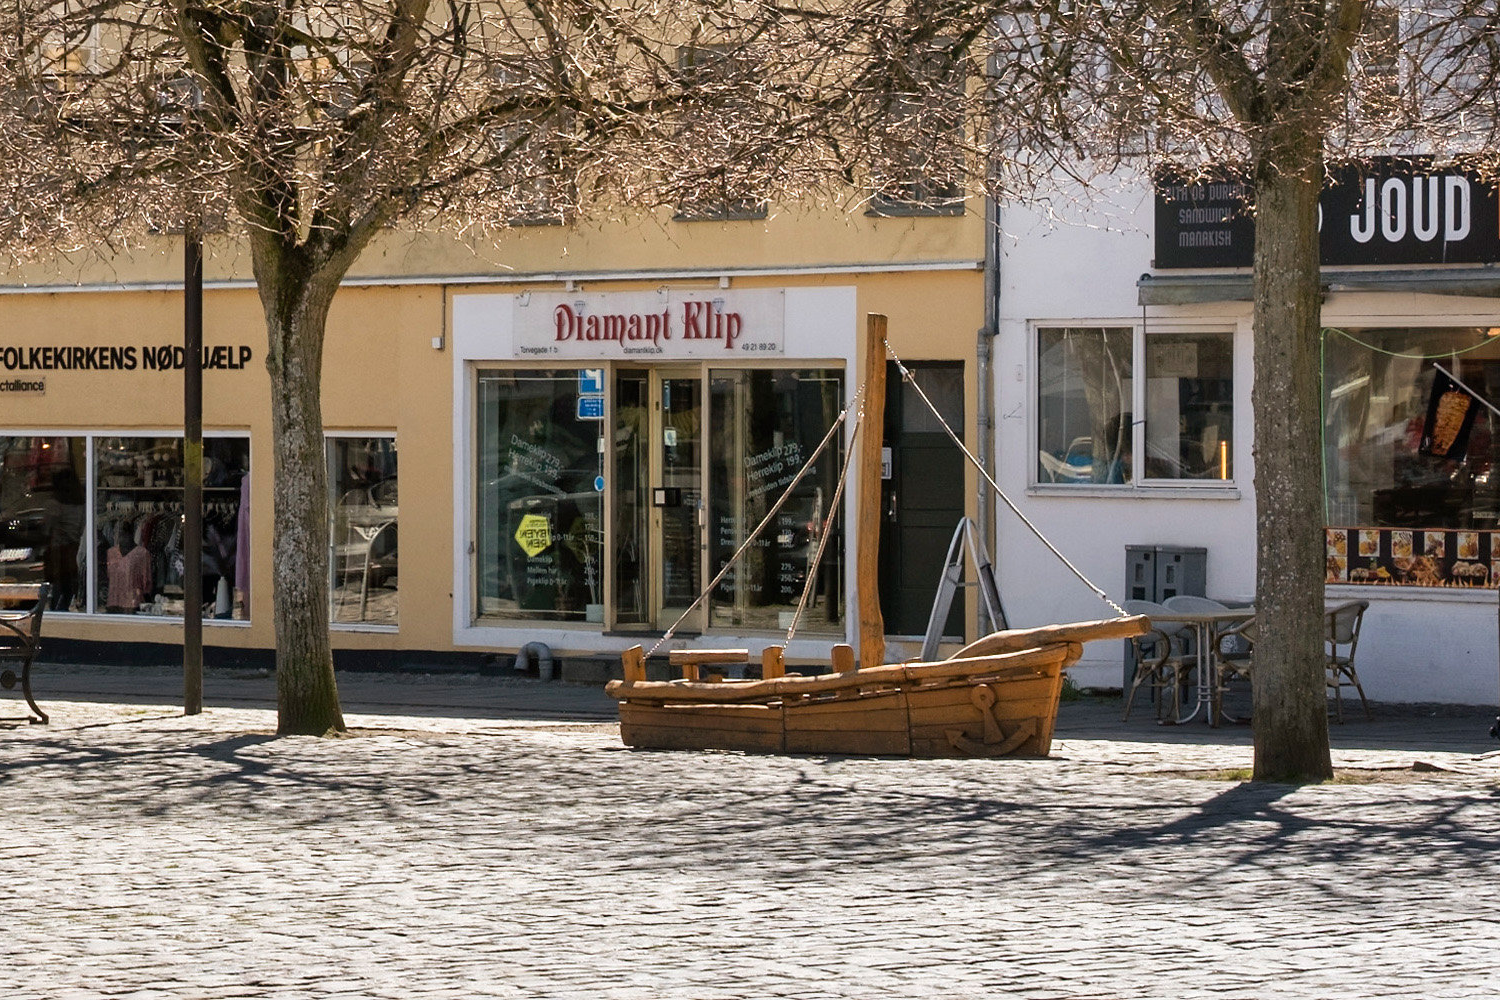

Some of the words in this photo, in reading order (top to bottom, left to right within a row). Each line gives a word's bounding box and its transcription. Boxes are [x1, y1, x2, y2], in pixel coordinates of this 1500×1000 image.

[1179, 207, 1231, 224] SANDWICH
[1350, 175, 1471, 243] JOUD
[1179, 230, 1232, 247] MANAKISH
[554, 303, 672, 347] Diamant
[682, 301, 742, 349] Klip
[143, 344, 252, 371] NØDJÆLP
[744, 446, 782, 468] Dameklip
[747, 462, 783, 482] Herreklip
